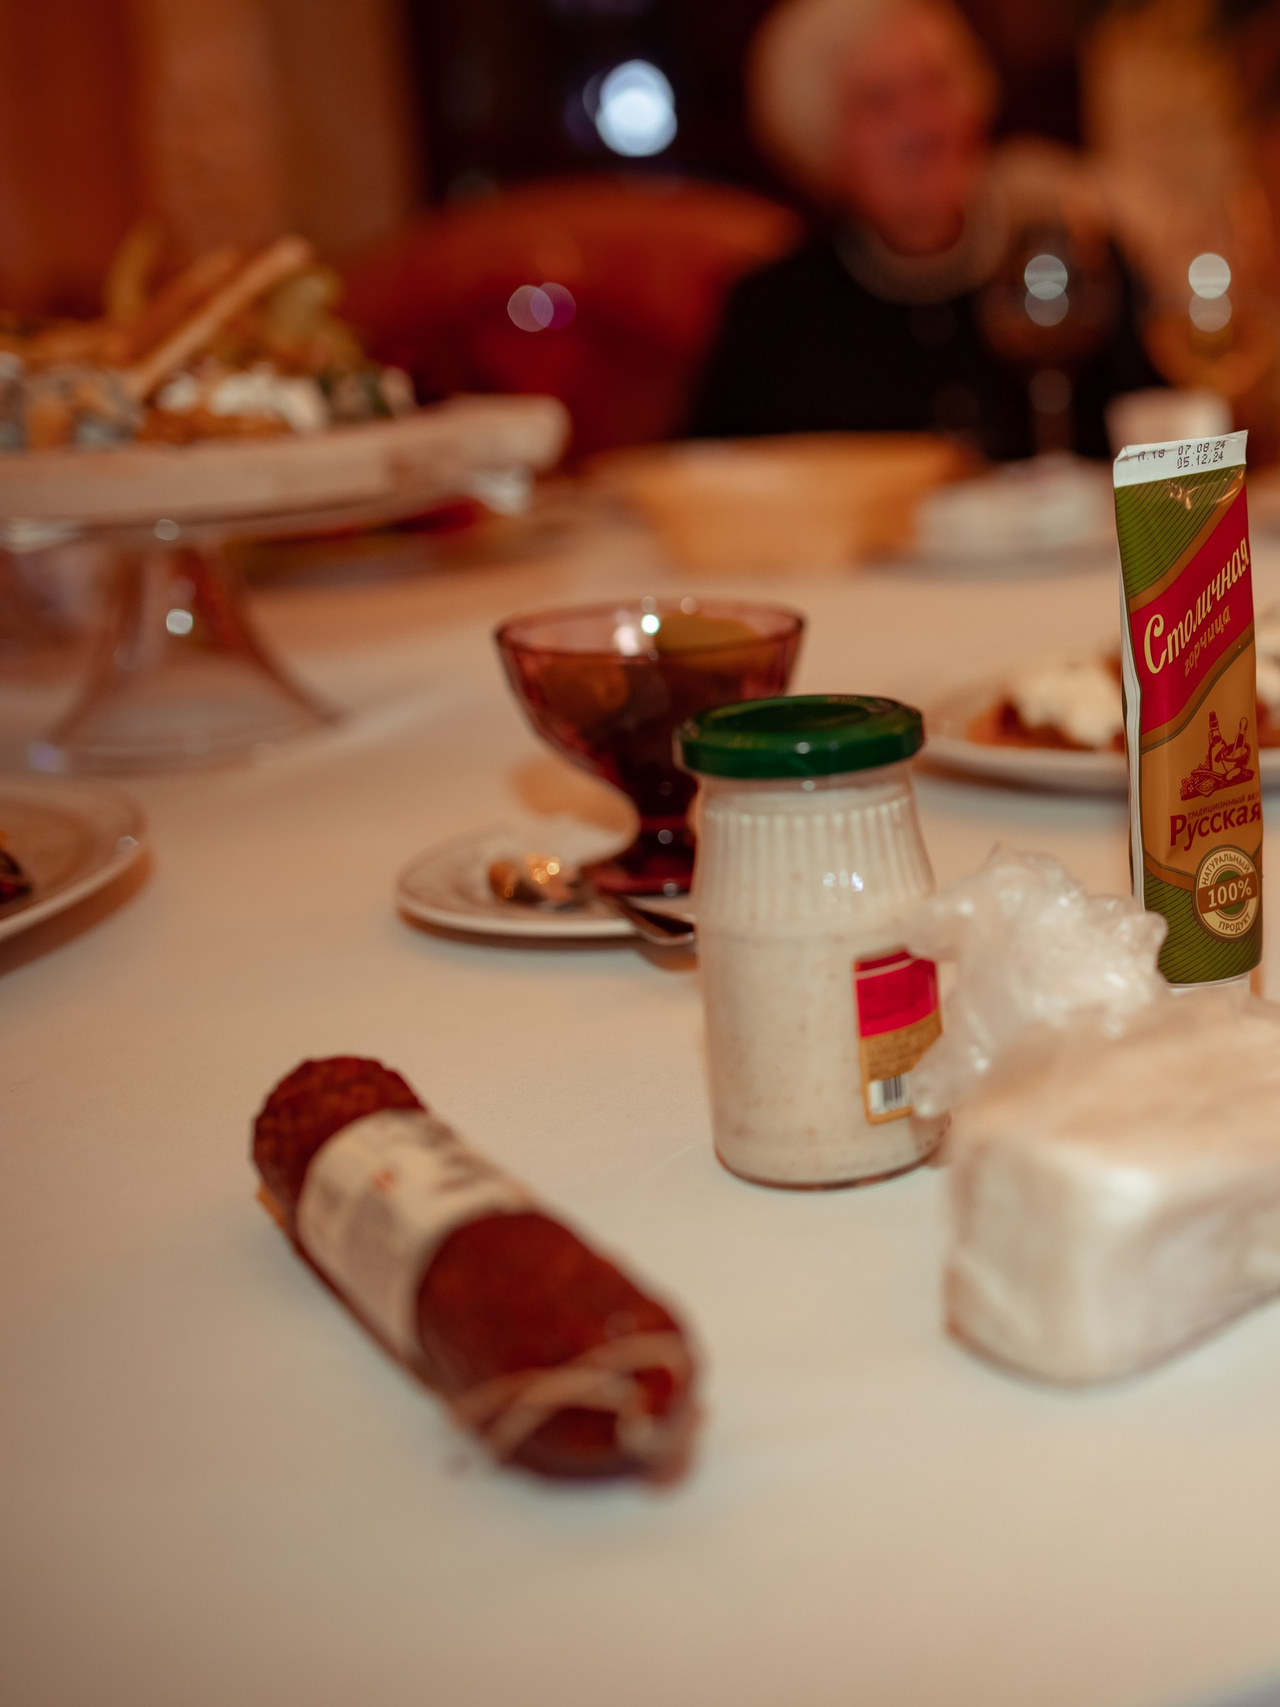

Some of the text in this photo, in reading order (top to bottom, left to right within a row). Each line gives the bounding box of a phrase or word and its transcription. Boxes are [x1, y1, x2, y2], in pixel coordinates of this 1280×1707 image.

[1177, 440, 1226, 456] 07.08.24
[1144, 537, 1250, 674] Столичная
[1185, 605, 1231, 677] горчица
[1188, 794, 1246, 820] ТРАДИЦИОННЫЙ
[1170, 802, 1262, 852] Русская
[1201, 853, 1251, 886] НАТУРАЛЬНЫЙ
[1208, 877, 1252, 908] 100%
[1218, 911, 1251, 933] ПРОДУКТ
